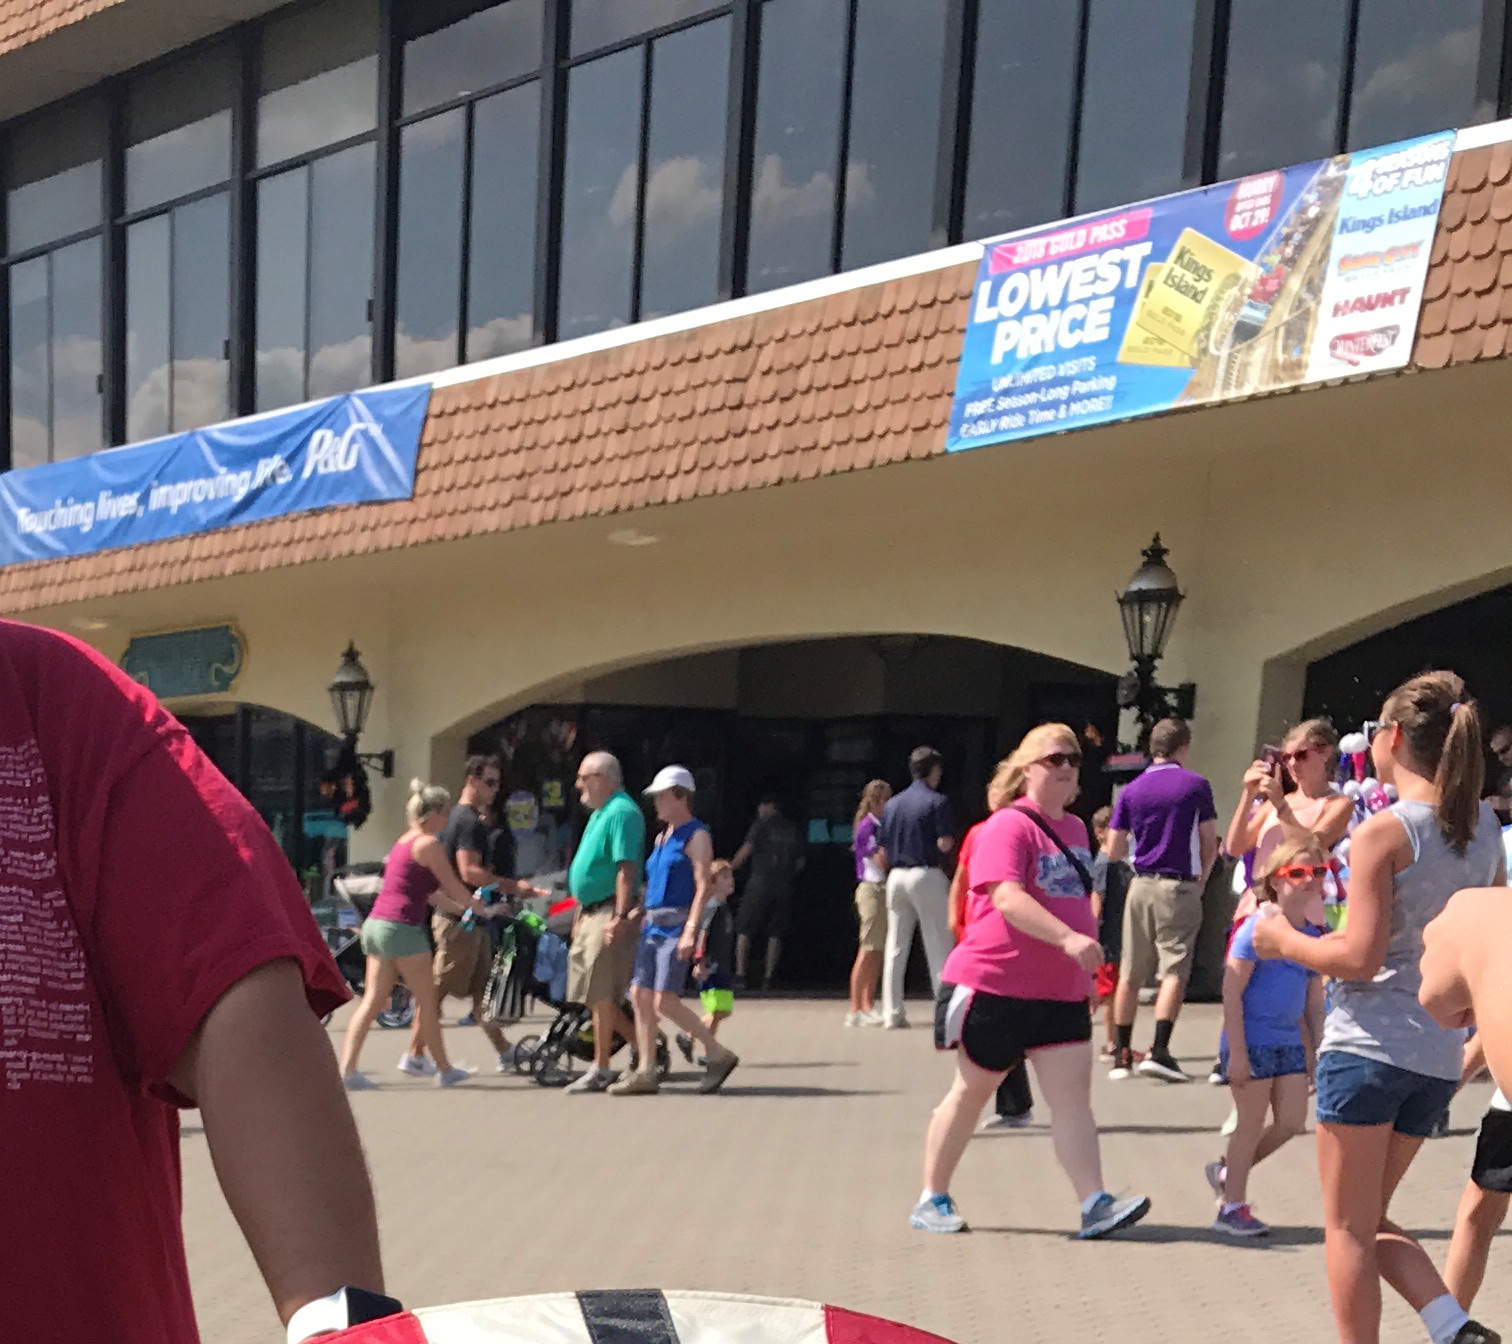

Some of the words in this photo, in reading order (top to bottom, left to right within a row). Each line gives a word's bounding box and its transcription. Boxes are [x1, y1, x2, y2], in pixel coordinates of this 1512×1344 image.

[1400, 161, 1446, 190] FUN
[1089, 218, 1129, 244] PASS
[1338, 215, 1384, 235] Kings
[1388, 198, 1439, 225] Island
[1174, 245, 1215, 283] Kings
[974, 242, 1153, 323] LOWEST
[1163, 267, 1209, 305] Island
[1332, 286, 1411, 318] HAUNT
[991, 297, 1115, 364] PRICE
[1058, 356, 1096, 376] VISITS
[1071, 375, 1117, 396] Parking
[1028, 407, 1056, 425] Time
[16, 499, 95, 534] Touching
[97, 490, 144, 518] lives,
[149, 467, 251, 514] improving
[300, 423, 373, 480] P&G
